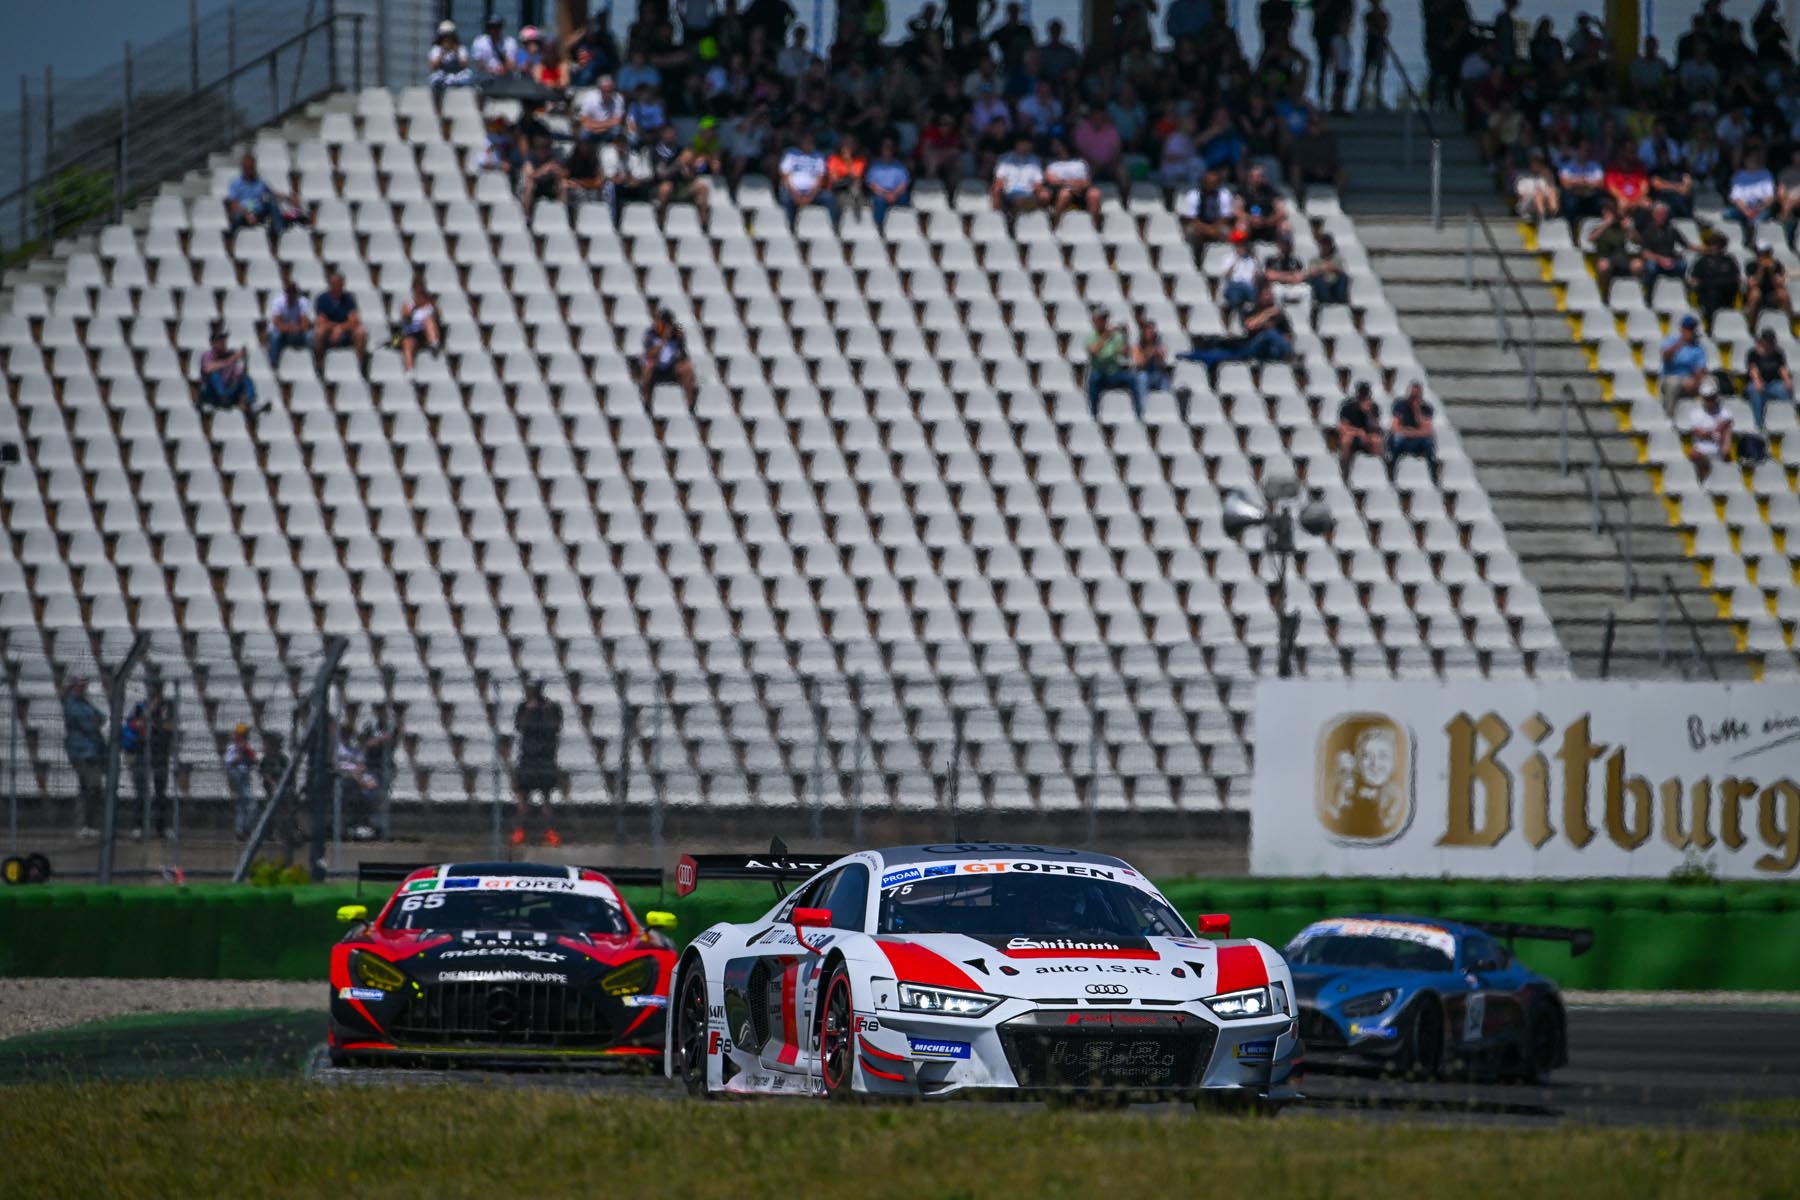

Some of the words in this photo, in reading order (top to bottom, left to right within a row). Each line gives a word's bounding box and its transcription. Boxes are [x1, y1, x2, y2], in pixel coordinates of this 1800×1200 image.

[1434, 711, 1800, 871] Bitburg
[882, 868, 920, 885] PROAM
[888, 884, 913, 898] 75
[401, 893, 446, 912] 65
[1035, 964, 1089, 975] auto
[1096, 964, 1161, 977] I.S.R.
[914, 1043, 963, 1053] MICHELIN
